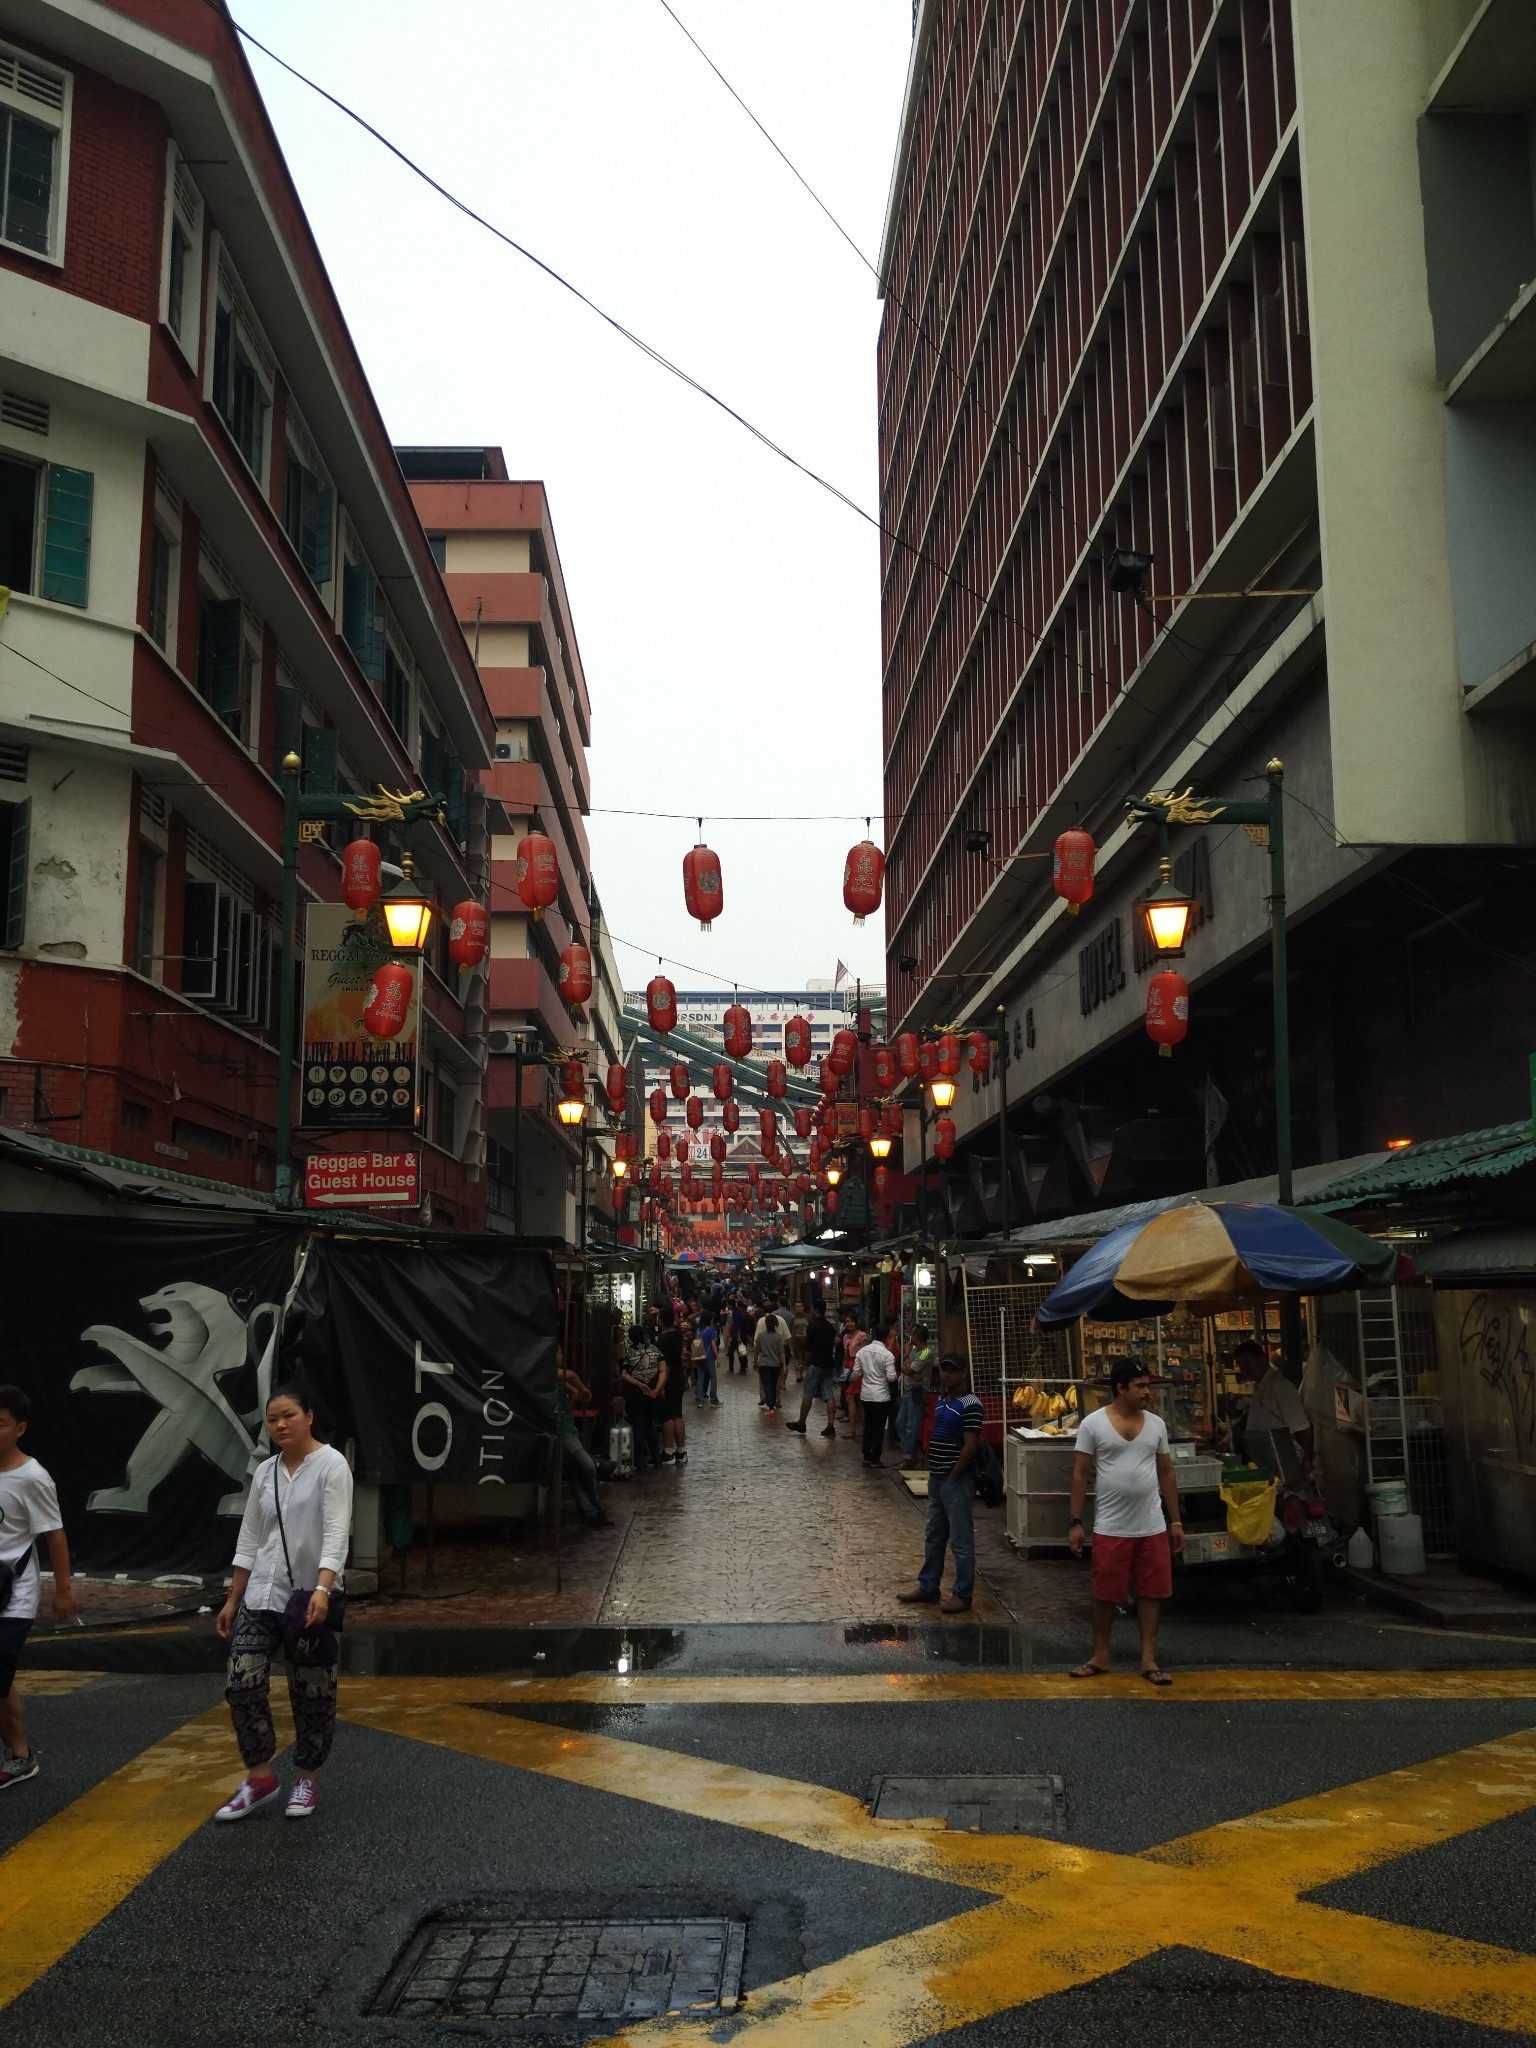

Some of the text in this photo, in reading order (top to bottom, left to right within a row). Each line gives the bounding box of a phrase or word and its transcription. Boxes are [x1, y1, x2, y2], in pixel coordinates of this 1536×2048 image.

[1079, 917, 1125, 1016] HOTEL
[328, 972, 360, 988] Guest
[337, 1042, 359, 1062] ALL
[395, 1042, 415, 1062] ALL
[696, 1147, 708, 1159] 24
[307, 1152, 416, 1173] Reggae Bar &
[308, 1172, 416, 1189] Guest House
